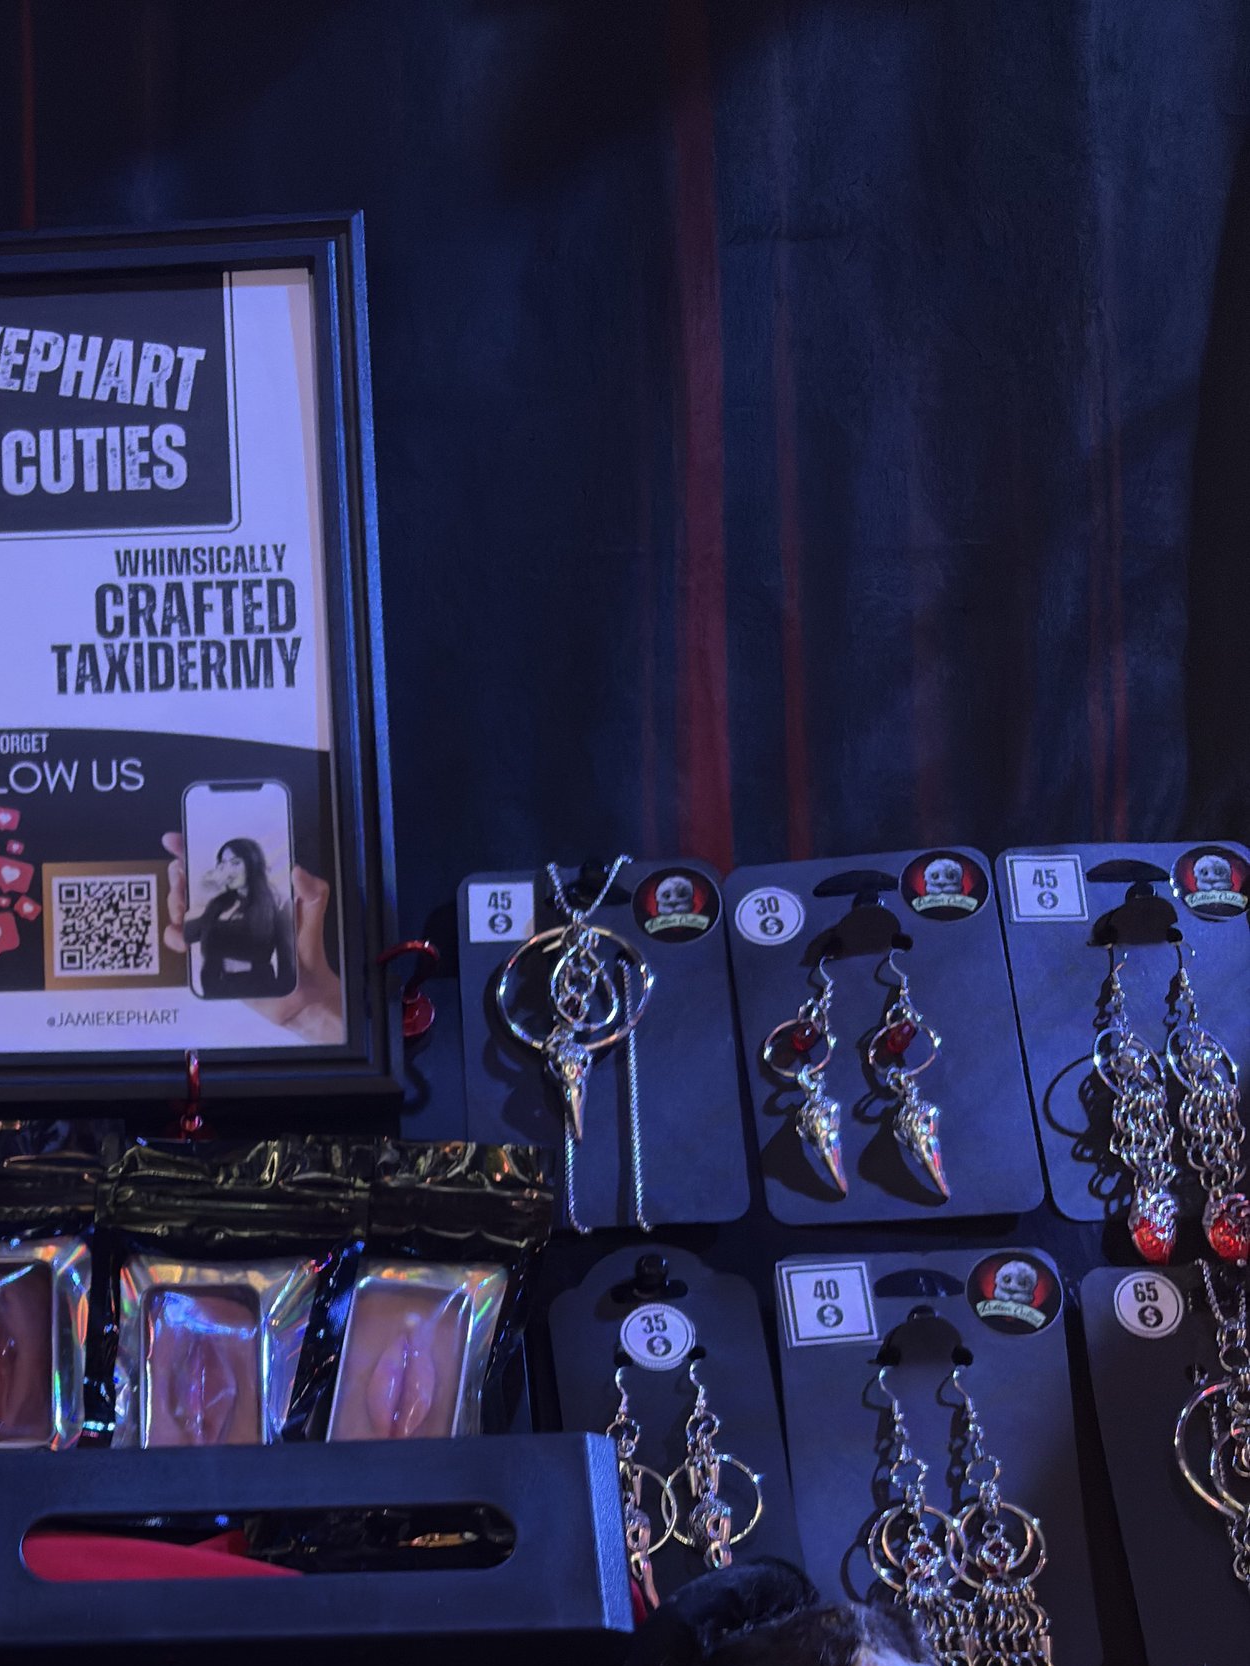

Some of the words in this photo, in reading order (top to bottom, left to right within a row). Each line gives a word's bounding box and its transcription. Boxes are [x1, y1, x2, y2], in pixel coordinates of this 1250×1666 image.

[0, 423, 189, 496] CUTIES
[114, 543, 286, 578] WHIMSICALLY
[94, 578, 296, 639] CRAFTED
[50, 637, 302, 696] TAXIDERMY
[91, 758, 145, 792] US
[1032, 868, 1059, 889] 45
[487, 890, 512, 911] 45
[753, 895, 780, 916] 30
[46, 1007, 179, 1028] @JAMIEKEPHART
[813, 1279, 840, 1300] 40
[1132, 1280, 1159, 1303] 65
[638, 1313, 667, 1335] 35
